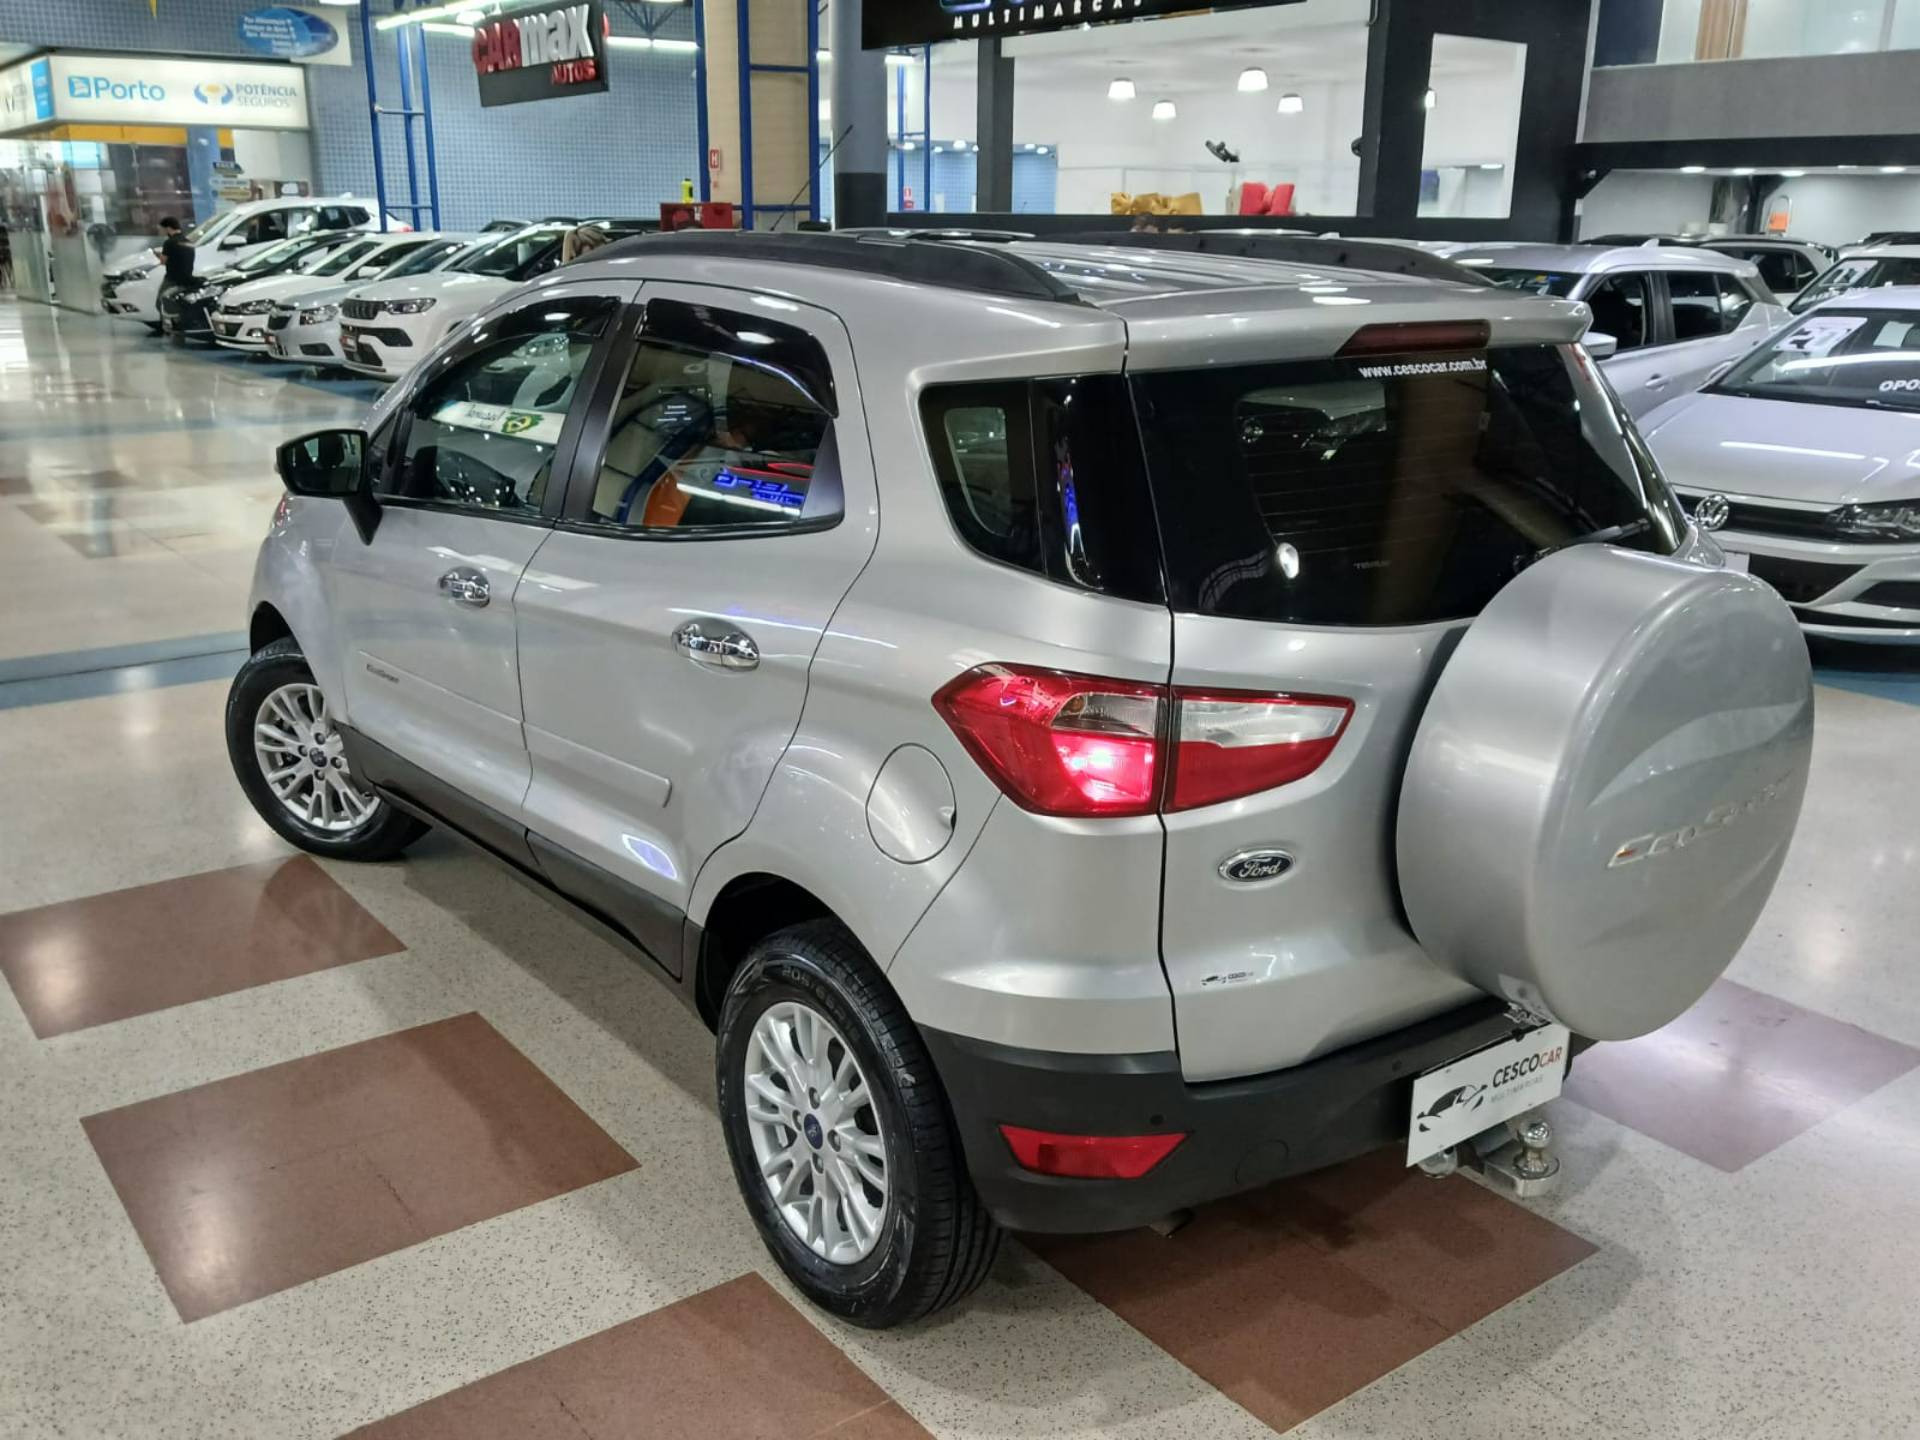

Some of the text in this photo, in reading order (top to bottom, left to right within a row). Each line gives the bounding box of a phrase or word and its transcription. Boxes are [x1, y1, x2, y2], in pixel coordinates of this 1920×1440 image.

[94, 77, 165, 102] Porto
[1358, 358, 1487, 378] www.cescocar.com.br
[1239, 857, 1282, 878] Ford
[1492, 1046, 1562, 1088] CESCOCAR
